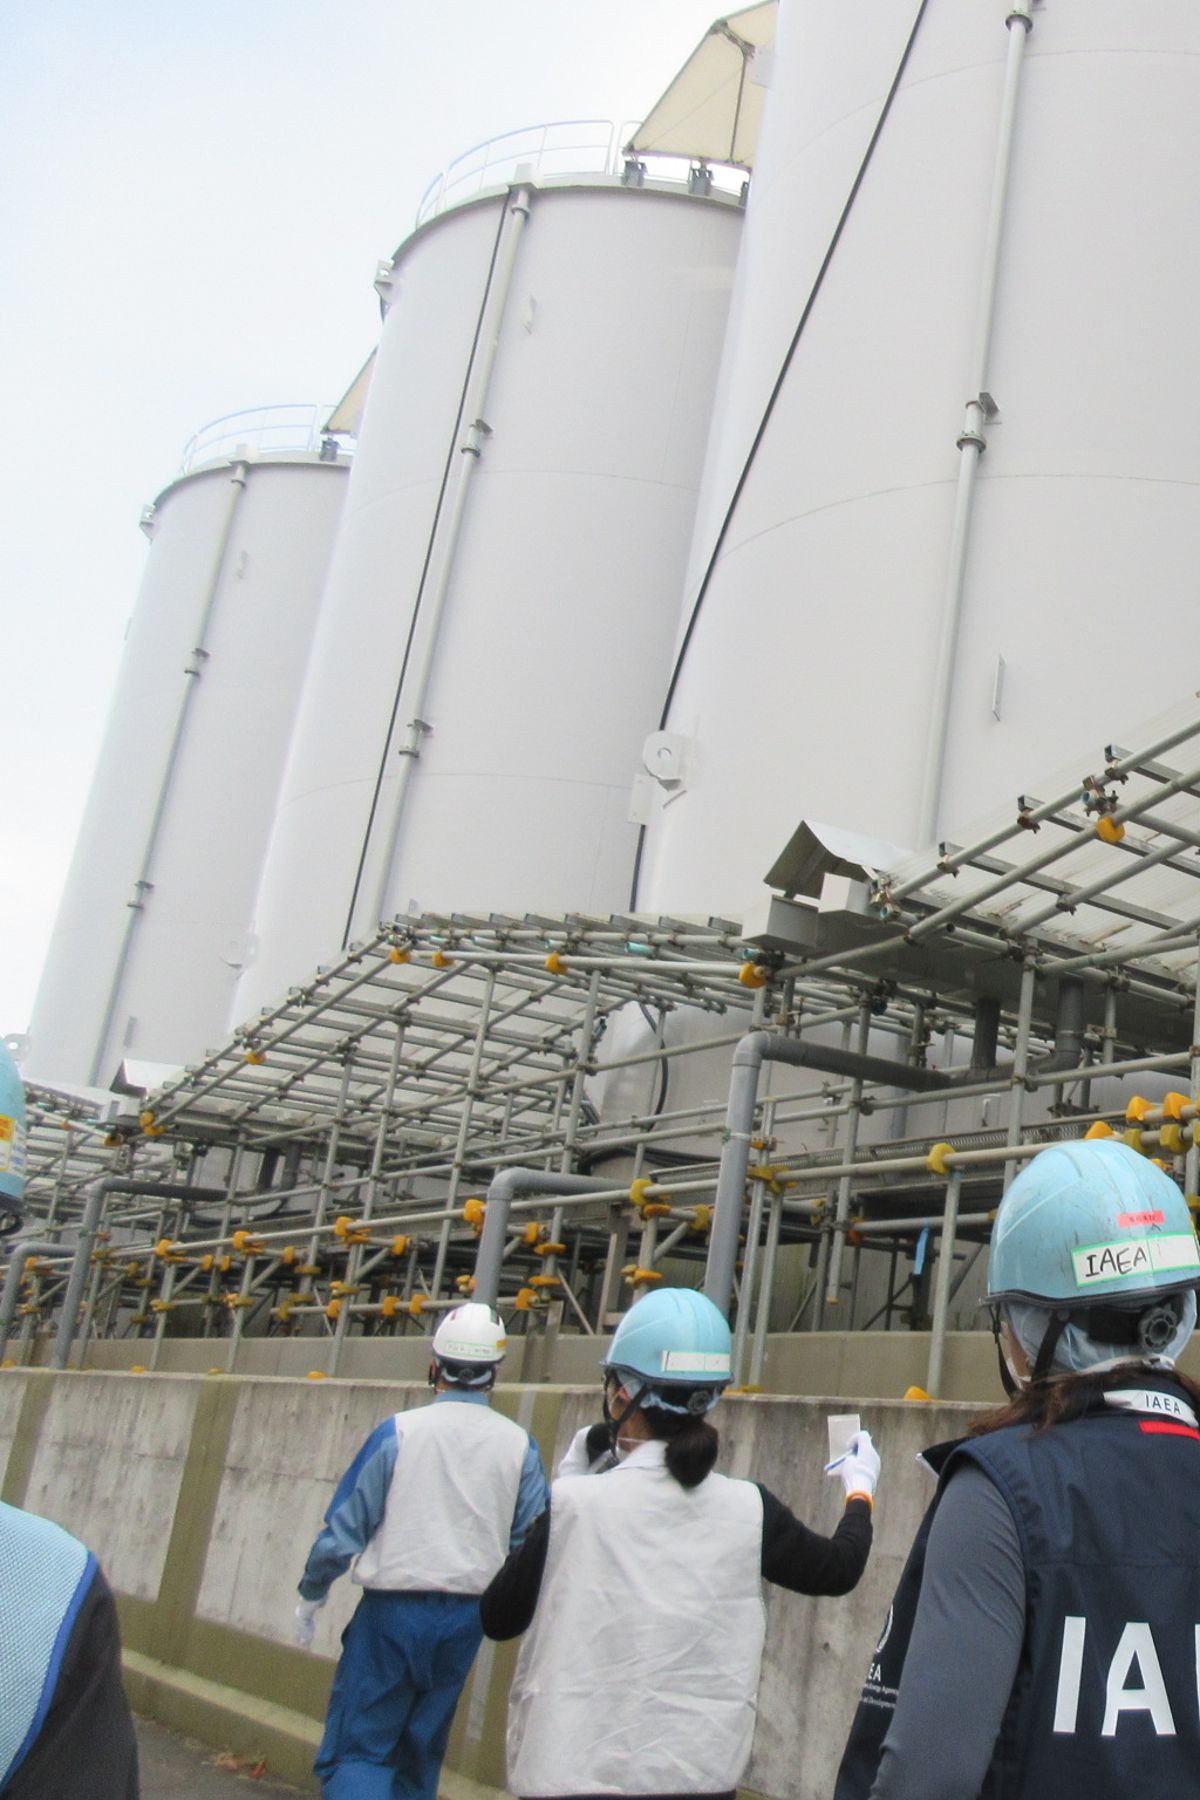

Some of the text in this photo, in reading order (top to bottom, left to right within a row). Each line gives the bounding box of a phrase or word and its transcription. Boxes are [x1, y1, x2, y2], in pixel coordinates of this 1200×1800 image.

[1085, 1246, 1148, 1278] IAEA
[1145, 1395, 1182, 1414] IAEA
[868, 1663, 881, 1682] EA
